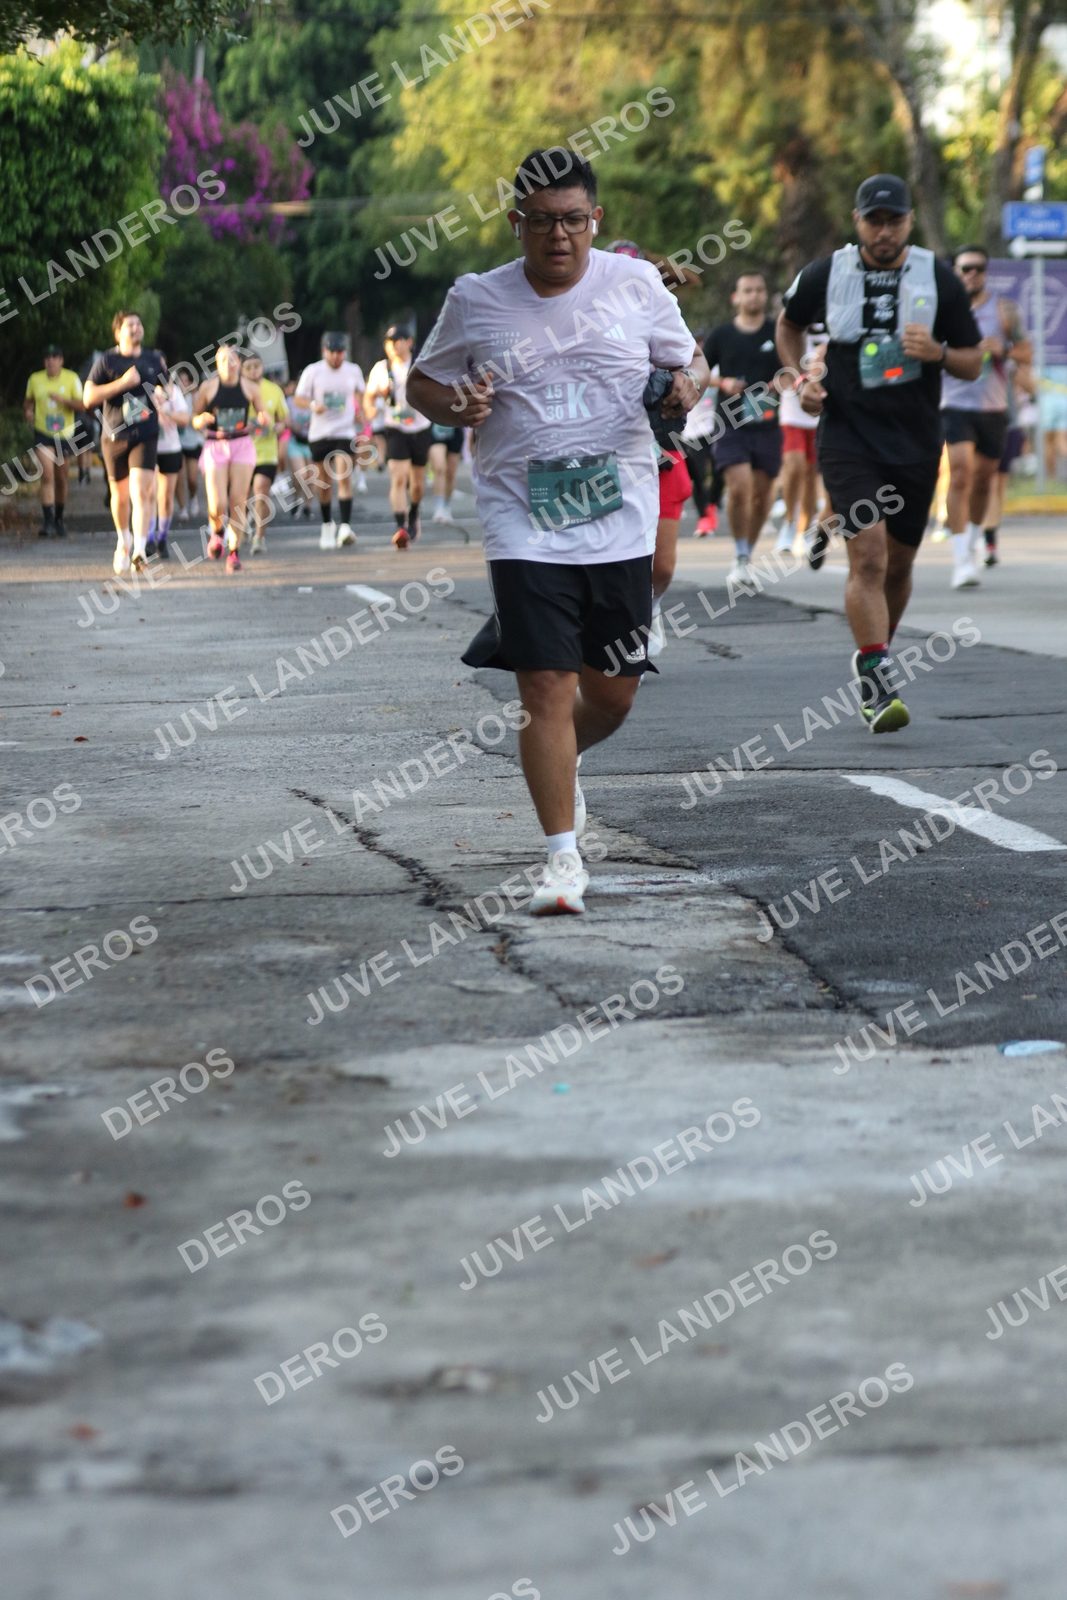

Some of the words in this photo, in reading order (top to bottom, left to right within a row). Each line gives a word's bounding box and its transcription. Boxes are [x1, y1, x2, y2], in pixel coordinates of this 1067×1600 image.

[545, 384, 562, 399] 15
[567, 383, 592, 419] K
[546, 405, 564, 420] 30
